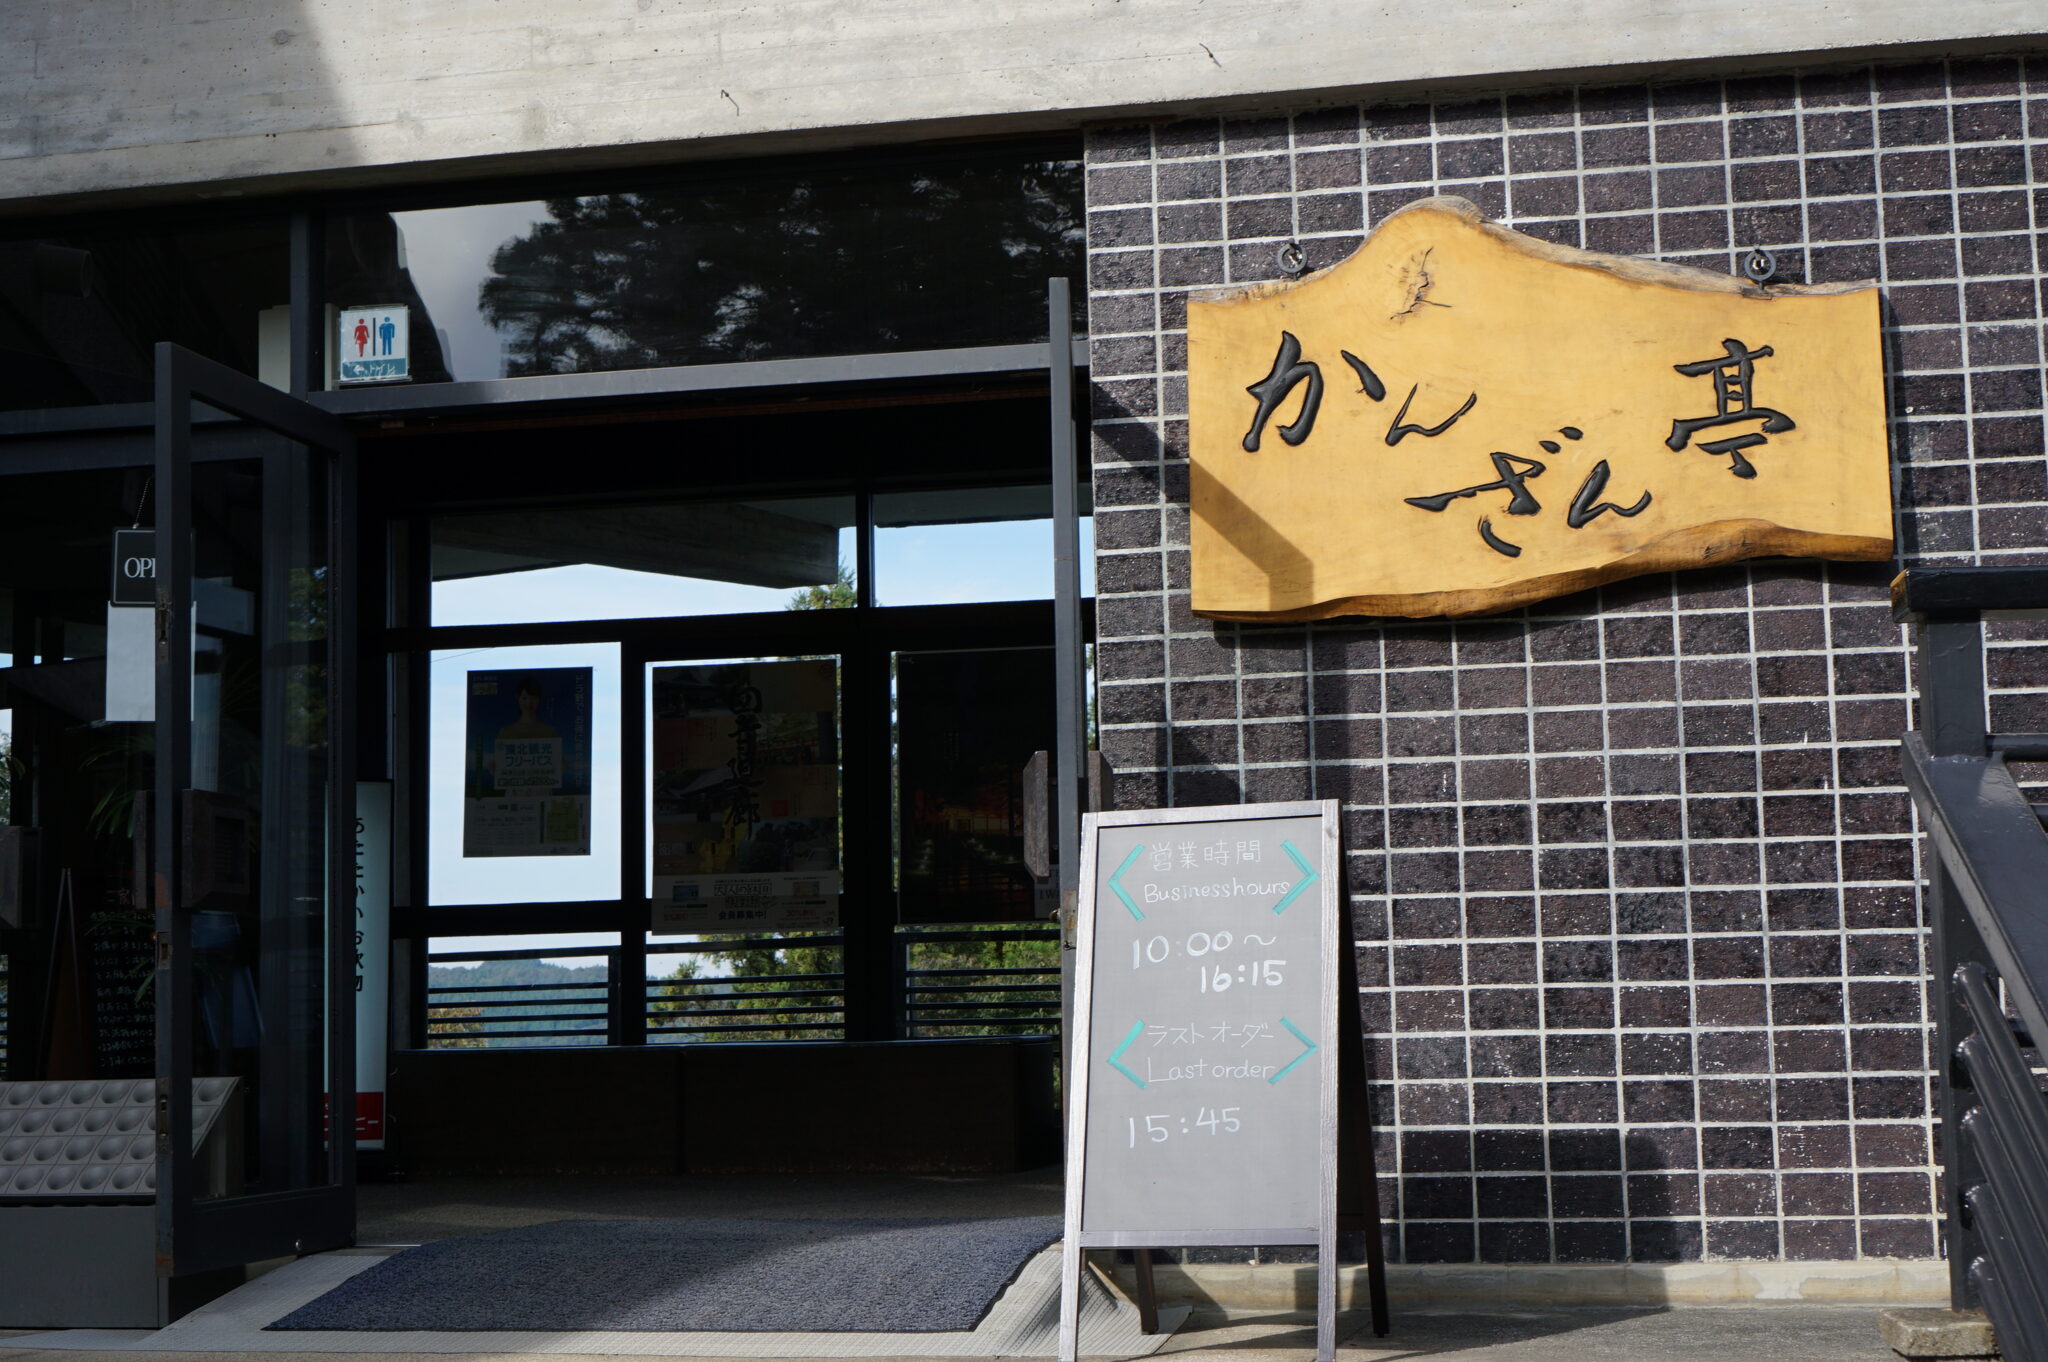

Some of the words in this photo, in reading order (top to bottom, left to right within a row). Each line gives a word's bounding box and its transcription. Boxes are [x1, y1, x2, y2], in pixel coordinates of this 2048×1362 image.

[1149, 839, 1262, 872] 営業時間
[1200, 960, 1287, 993] 16:15
[1147, 1056, 1208, 1083] Last
[1212, 1058, 1276, 1079] order
[1129, 1107, 1242, 1148] 15:45
